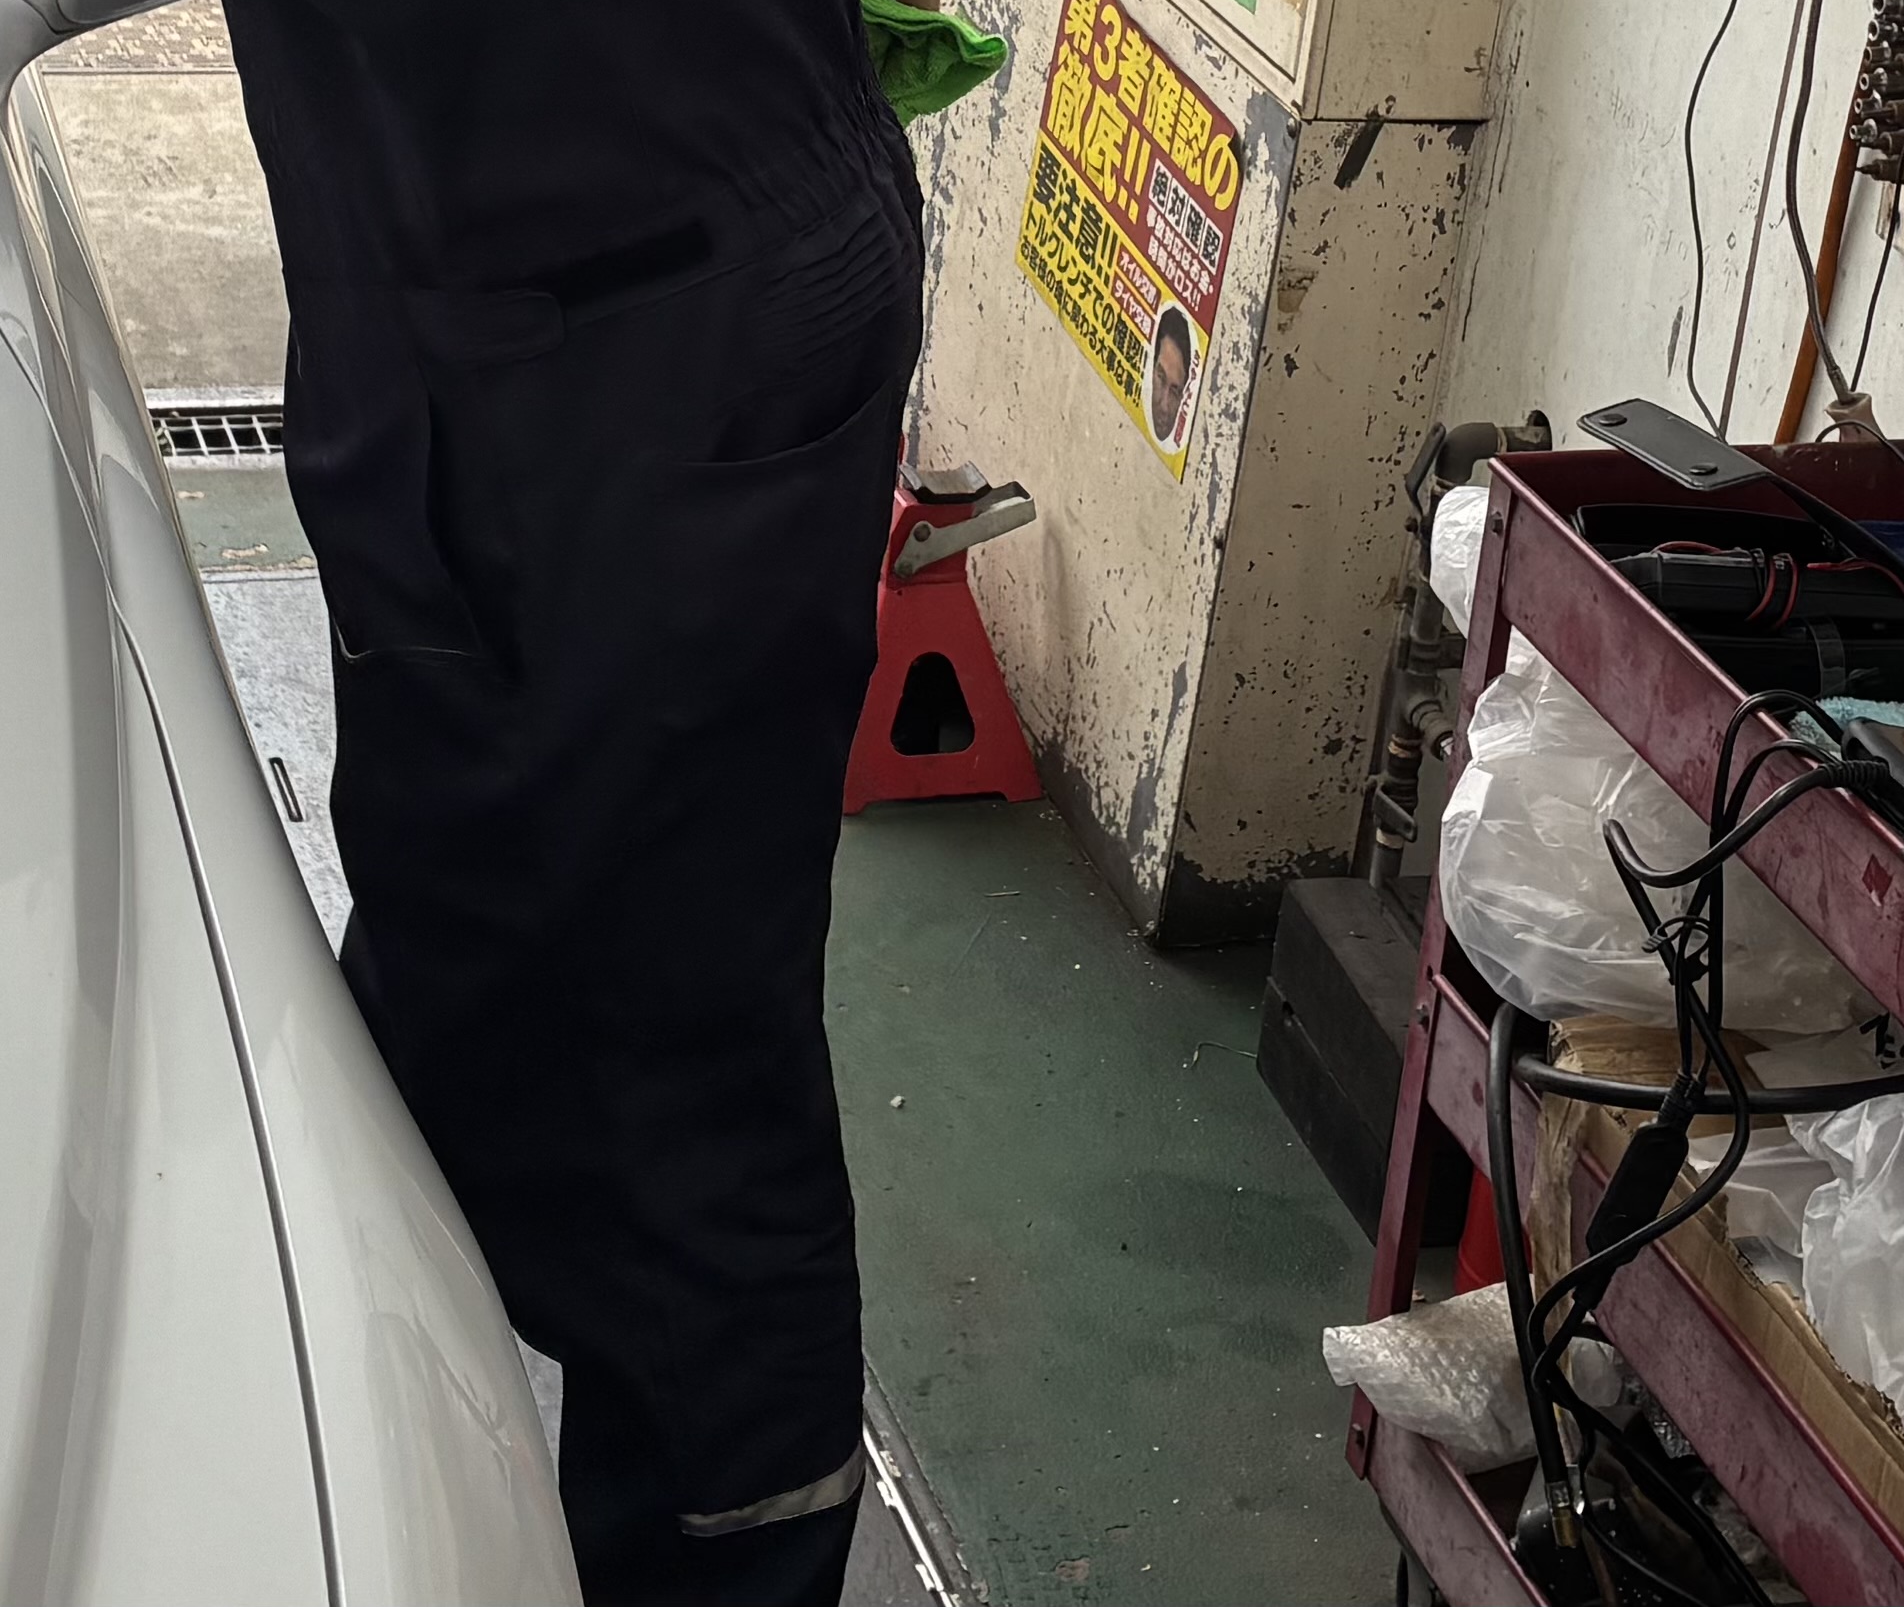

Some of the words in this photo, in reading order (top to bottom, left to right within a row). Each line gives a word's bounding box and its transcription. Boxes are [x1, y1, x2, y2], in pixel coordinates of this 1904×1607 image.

[1047, 39, 1152, 225] 徹底!!
[1032, 143, 1119, 289] 要注意!!
[1151, 163, 1223, 271] 絶対確認
